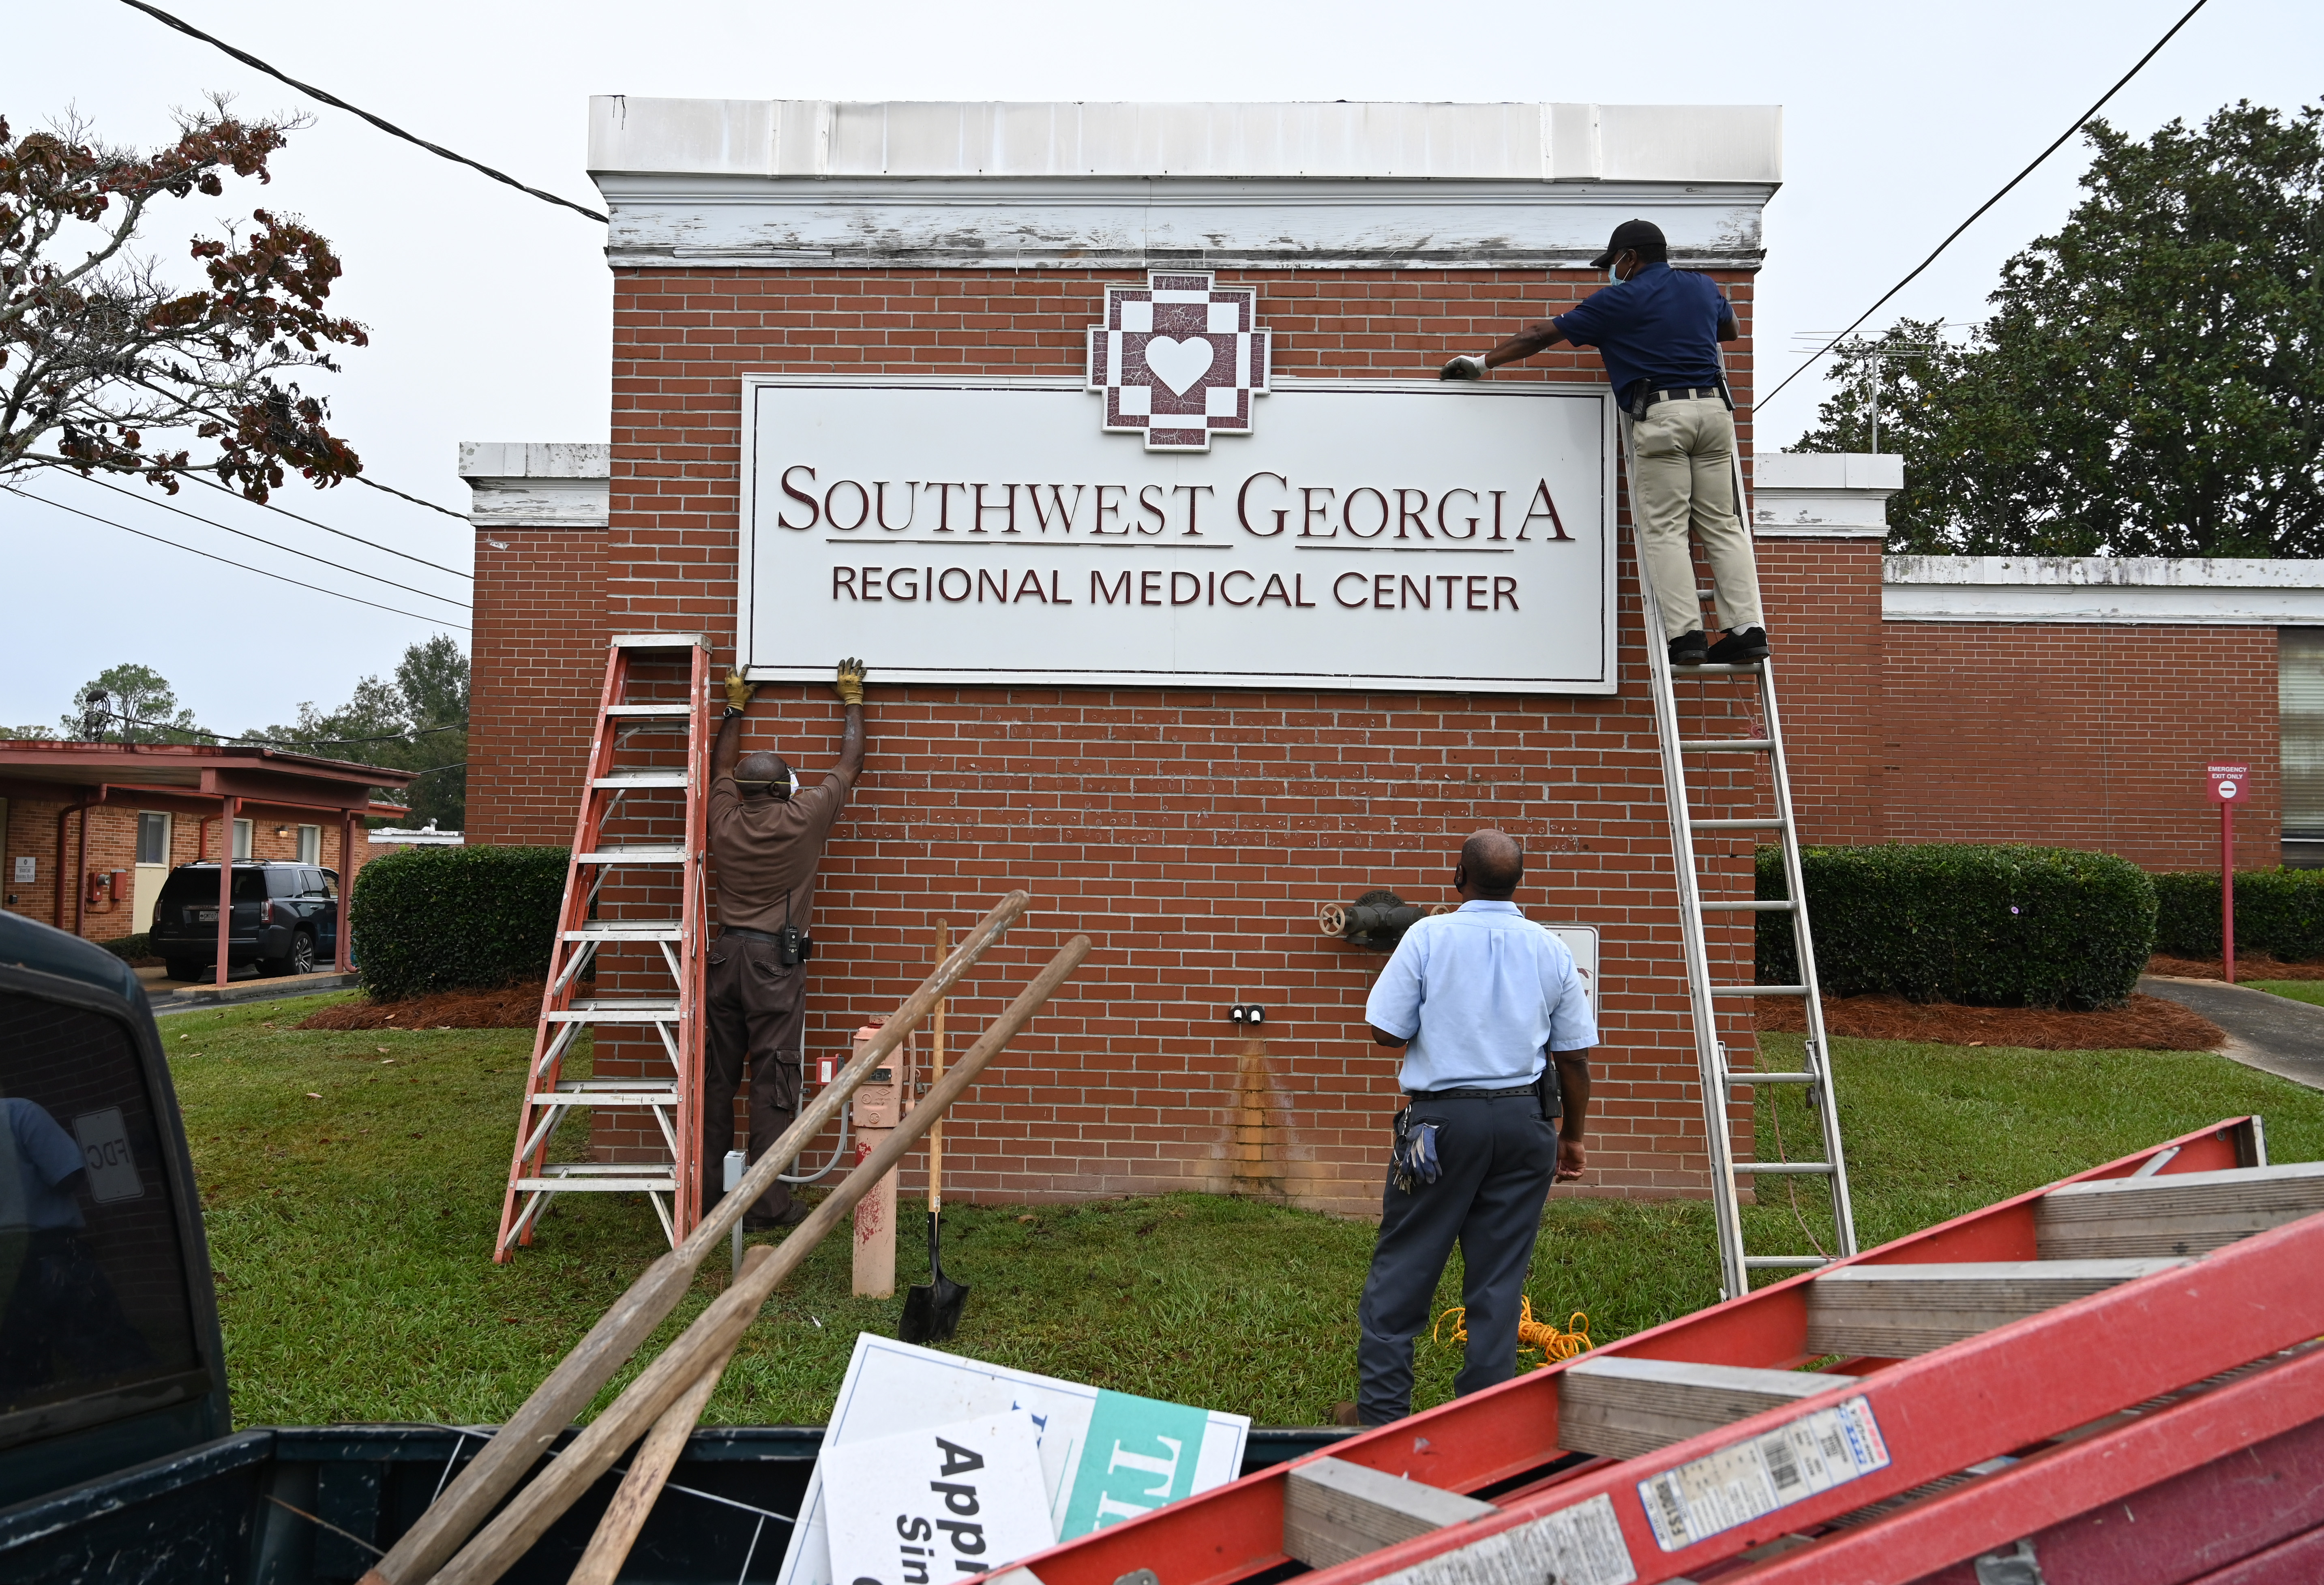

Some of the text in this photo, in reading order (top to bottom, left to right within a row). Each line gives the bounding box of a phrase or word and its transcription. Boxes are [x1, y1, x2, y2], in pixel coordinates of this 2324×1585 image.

[778, 465, 1576, 543] SOUTHWEST GEORGIA
[834, 566, 1520, 611] REGIONAL MEDICAL CENTER
[1377, 892, 1402, 907] TEST
[870, 1071, 889, 1080] PEN
